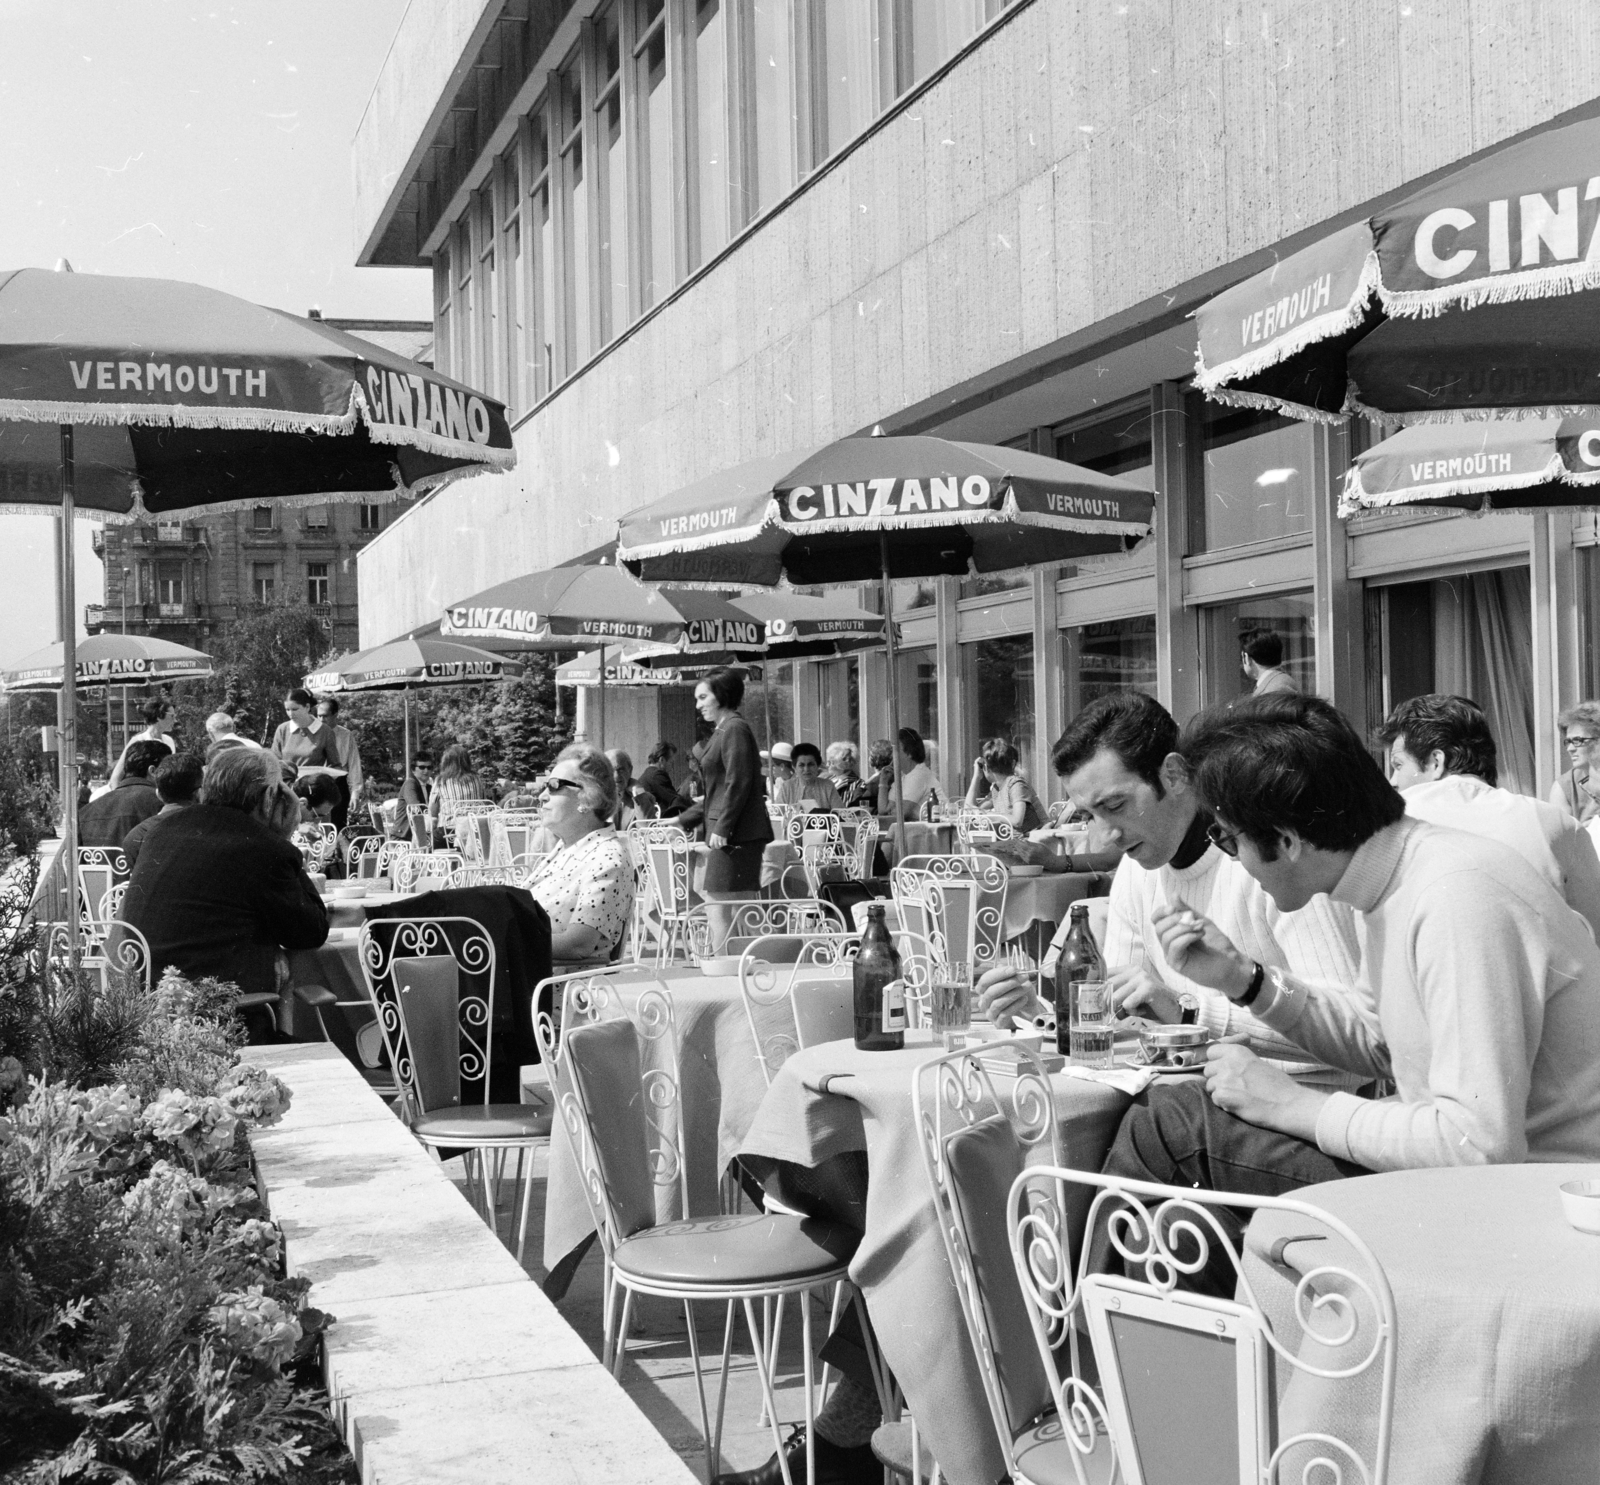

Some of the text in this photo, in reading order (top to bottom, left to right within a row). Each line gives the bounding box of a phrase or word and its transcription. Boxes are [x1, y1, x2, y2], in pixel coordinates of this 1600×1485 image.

[1241, 273, 1332, 347] VERMOUTH
[69, 360, 267, 397] VERMOUTH
[367, 365, 491, 446] CINZANO
[1410, 452, 1512, 482] VERMOUTH
[788, 474, 991, 520] CINZANO
[1046, 493, 1120, 519] VERMOUTH
[660, 506, 737, 537] VERMOUTH
[452, 607, 538, 632] CINZANO
[583, 621, 653, 637] VERMOUTH
[688, 618, 758, 643] CINZANO
[817, 620, 865, 632] VERMOUTH
[166, 659, 197, 669] VERMOUTH
[363, 668, 407, 681] VERMOUTH
[430, 660, 493, 677] CINZANO
